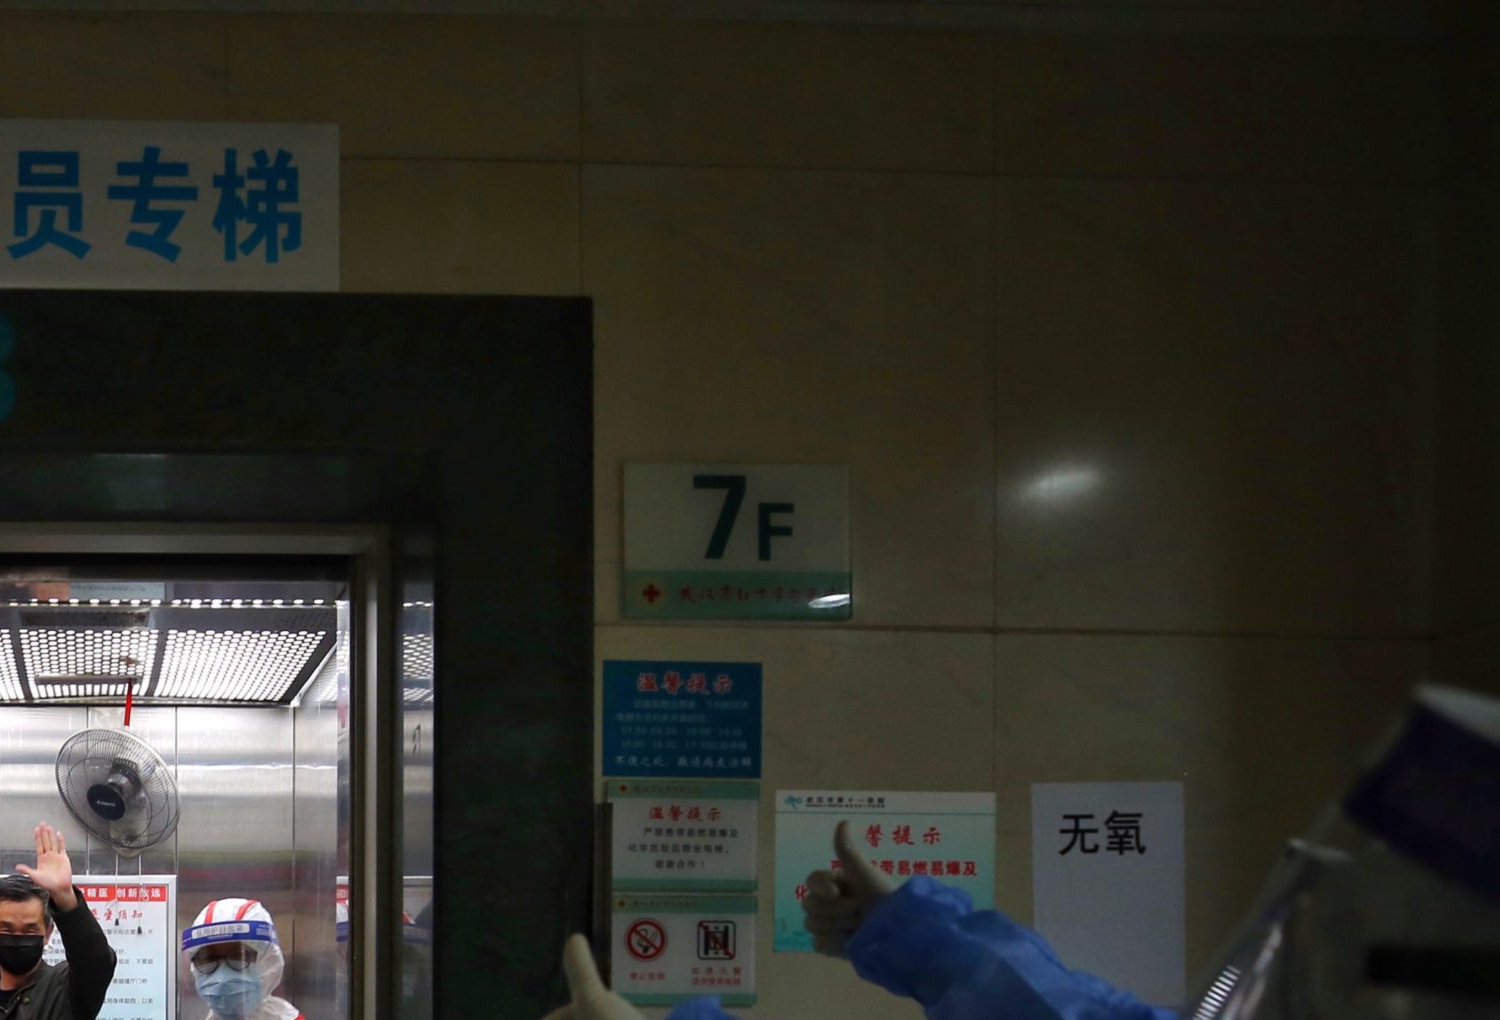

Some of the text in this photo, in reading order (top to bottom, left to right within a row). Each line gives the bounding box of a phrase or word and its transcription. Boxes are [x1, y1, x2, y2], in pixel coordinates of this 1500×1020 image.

[693, 474, 796, 562] 7F
[637, 671, 733, 695] 温馨提示
[649, 805, 722, 822] 温馨提示
[864, 824, 942, 848] 馨提示
[1059, 811, 1146, 858] 无氧
